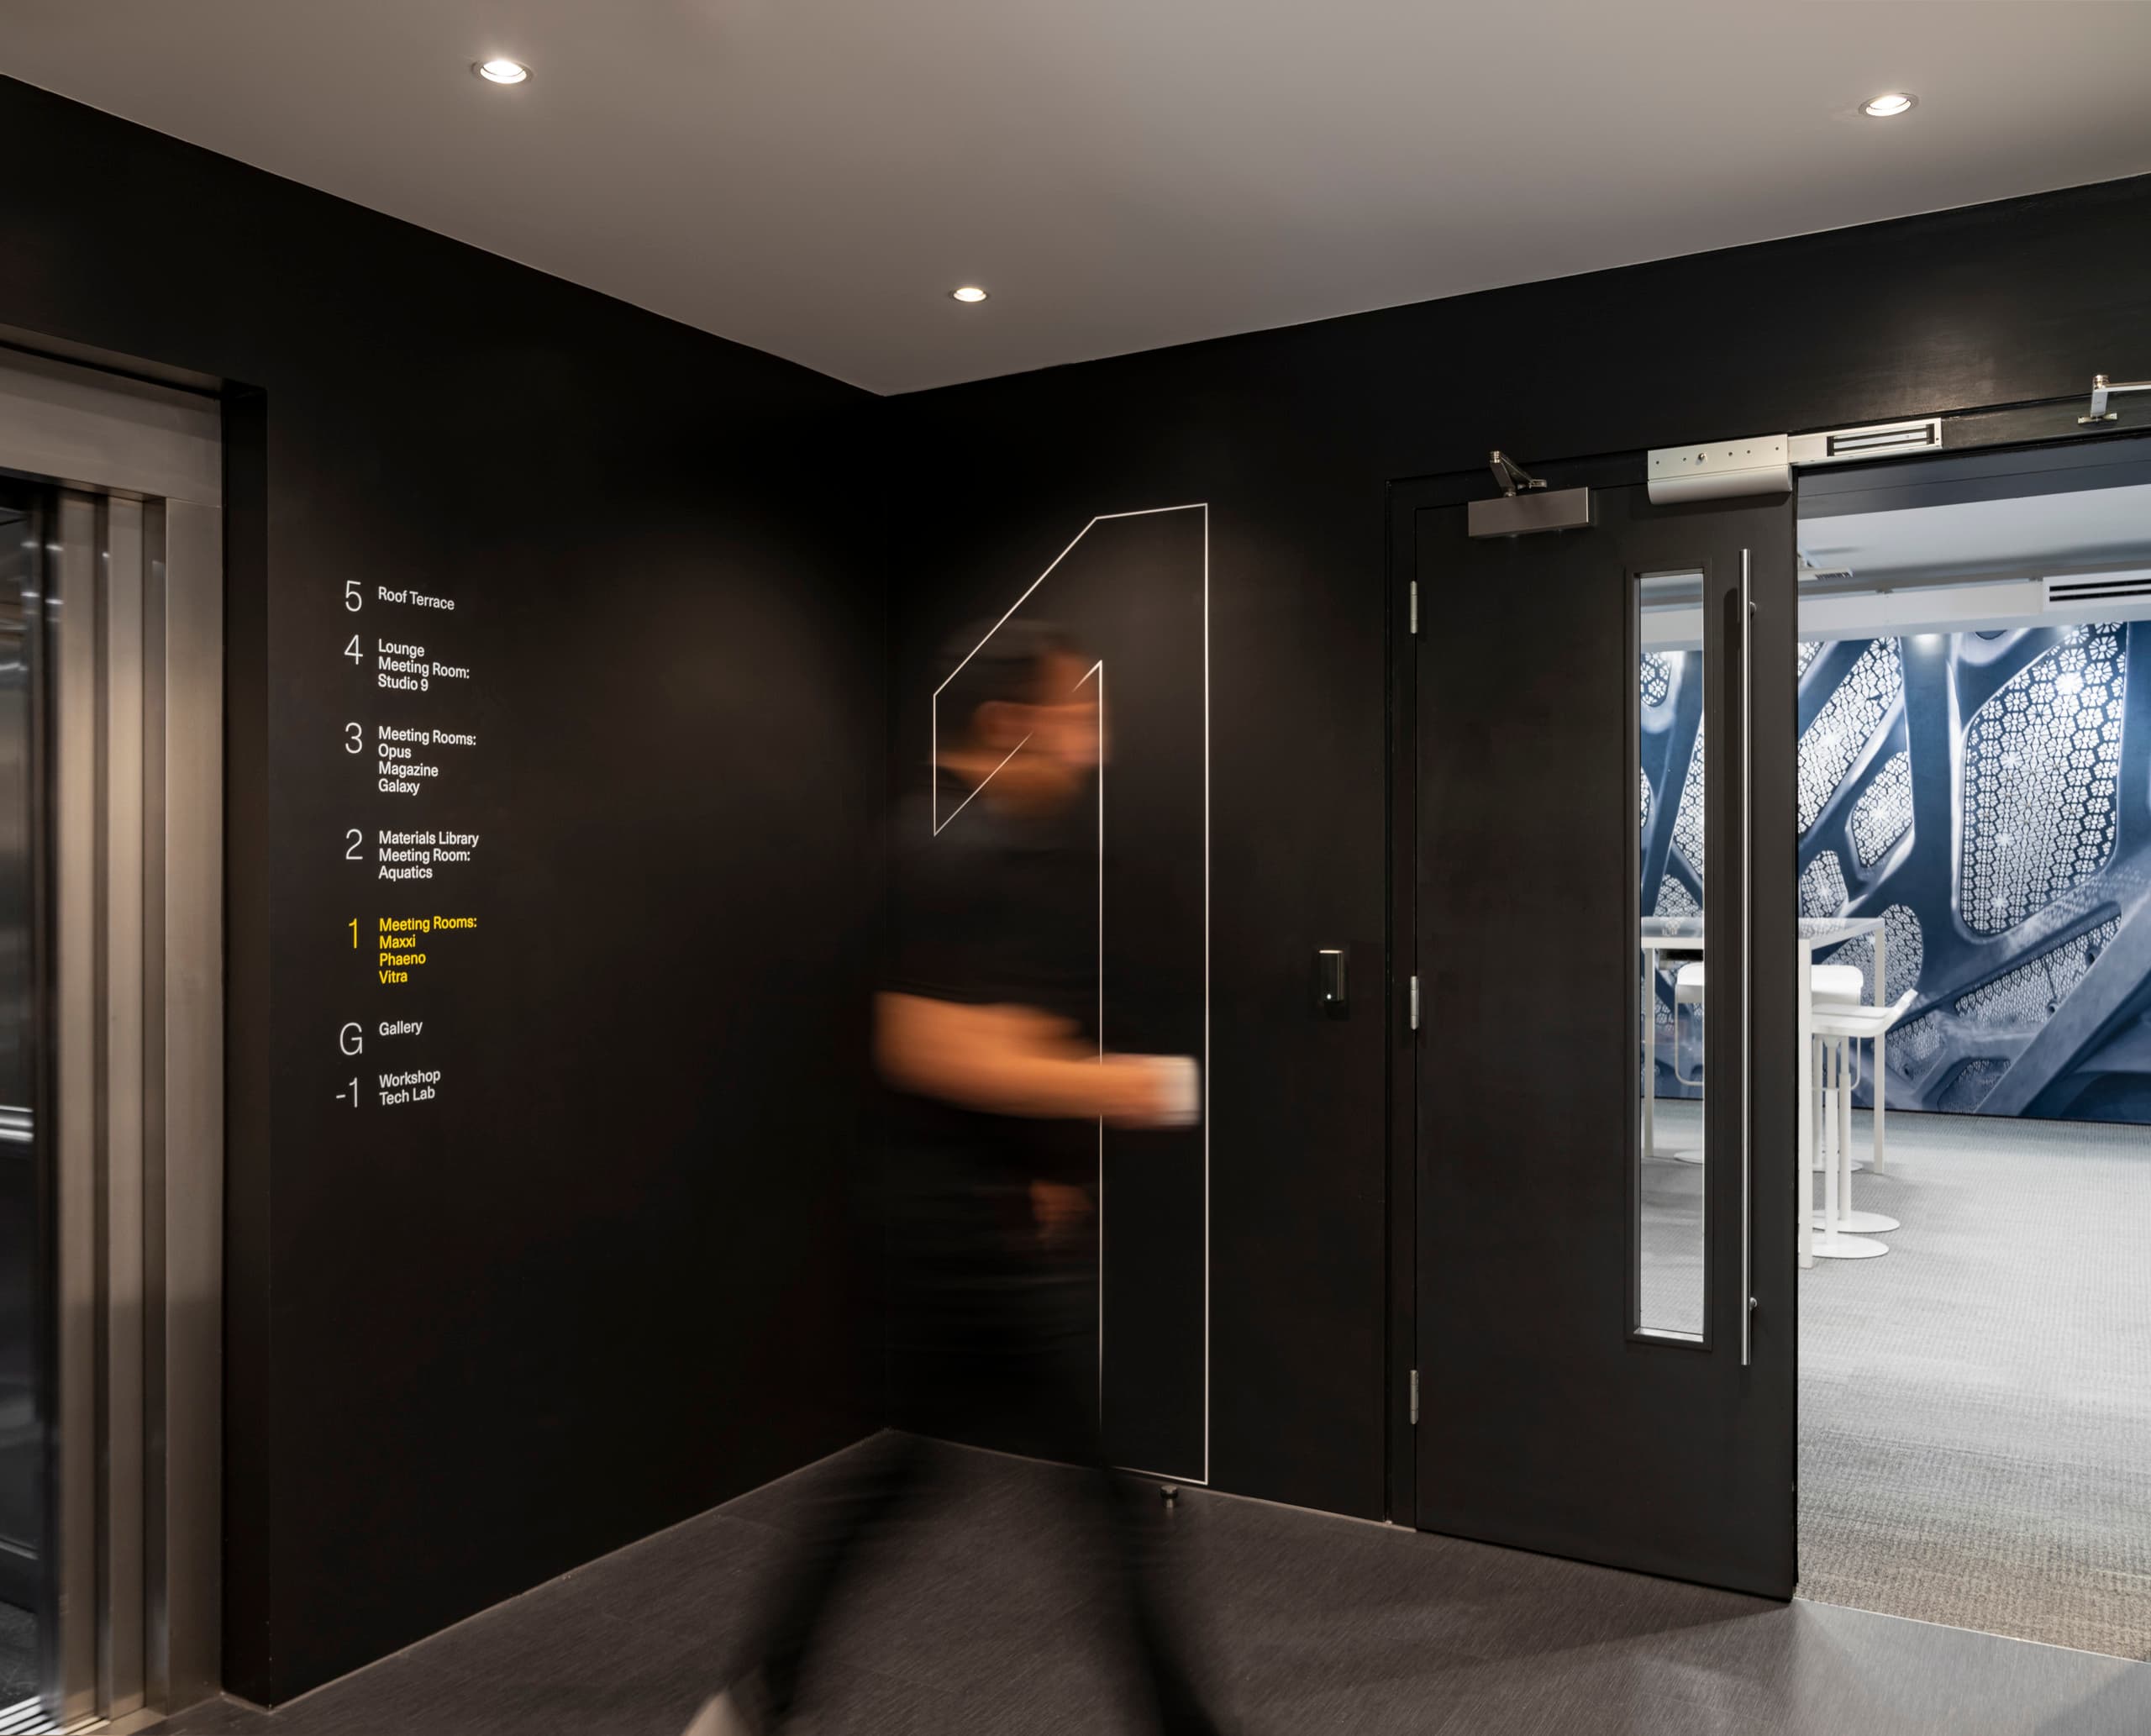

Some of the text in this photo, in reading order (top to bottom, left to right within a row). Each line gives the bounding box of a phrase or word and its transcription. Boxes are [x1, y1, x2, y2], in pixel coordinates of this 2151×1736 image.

[345, 581, 362, 612] 5
[379, 587, 455, 610] Roof Terrace
[344, 634, 363, 665] 4
[379, 639, 424, 659] Lounge
[379, 656, 470, 679] Meeting Room:
[378, 673, 429, 692] Studio 9
[345, 722, 362, 754] 3
[379, 726, 476, 745] Meeting Rooms:
[378, 743, 412, 760] Opus
[379, 760, 439, 778] Magazine
[378, 778, 420, 796] Galaxy
[346, 829, 363, 860] 2
[379, 830, 479, 848] Materials Library
[379, 848, 471, 865] Meeting Room:
[378, 865, 433, 881] Aquatics
[349, 918, 358, 949] 1
[380, 916, 476, 933] Meeting Rooms:
[380, 934, 415, 949] Maxxi
[380, 952, 426, 966] Phaeno
[379, 970, 408, 984] Vitra
[379, 1021, 423, 1036] Gallery
[340, 1023, 362, 1055] G
[379, 1070, 440, 1088] Workshop
[336, 1077, 358, 1107] -1
[379, 1086, 435, 1105] Tech Lab
